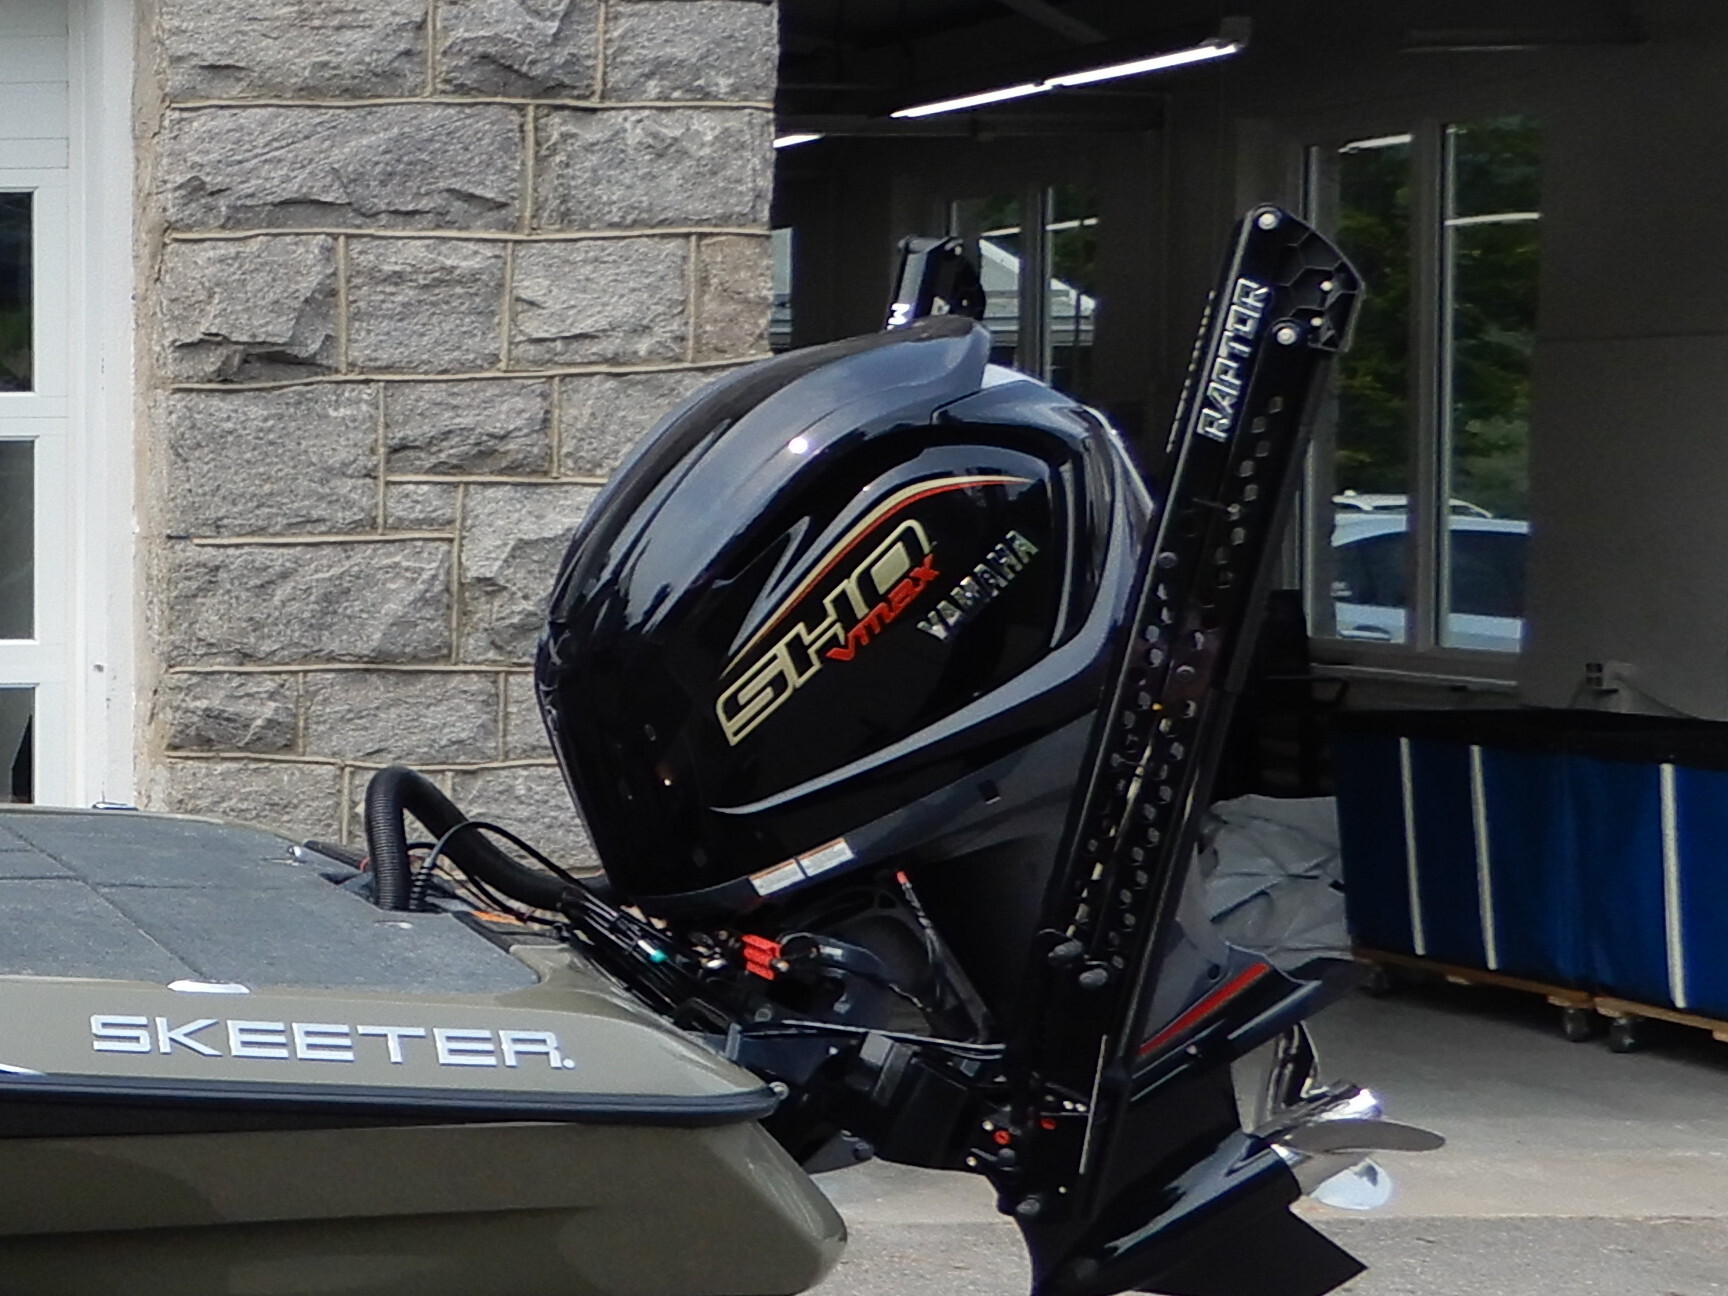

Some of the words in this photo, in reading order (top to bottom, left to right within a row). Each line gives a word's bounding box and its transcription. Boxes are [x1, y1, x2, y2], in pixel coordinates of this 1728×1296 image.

[1196, 277, 1270, 443] RAPTOR
[917, 529, 1040, 641] YAMAHA
[90, 1014, 564, 1070] SKEETER
